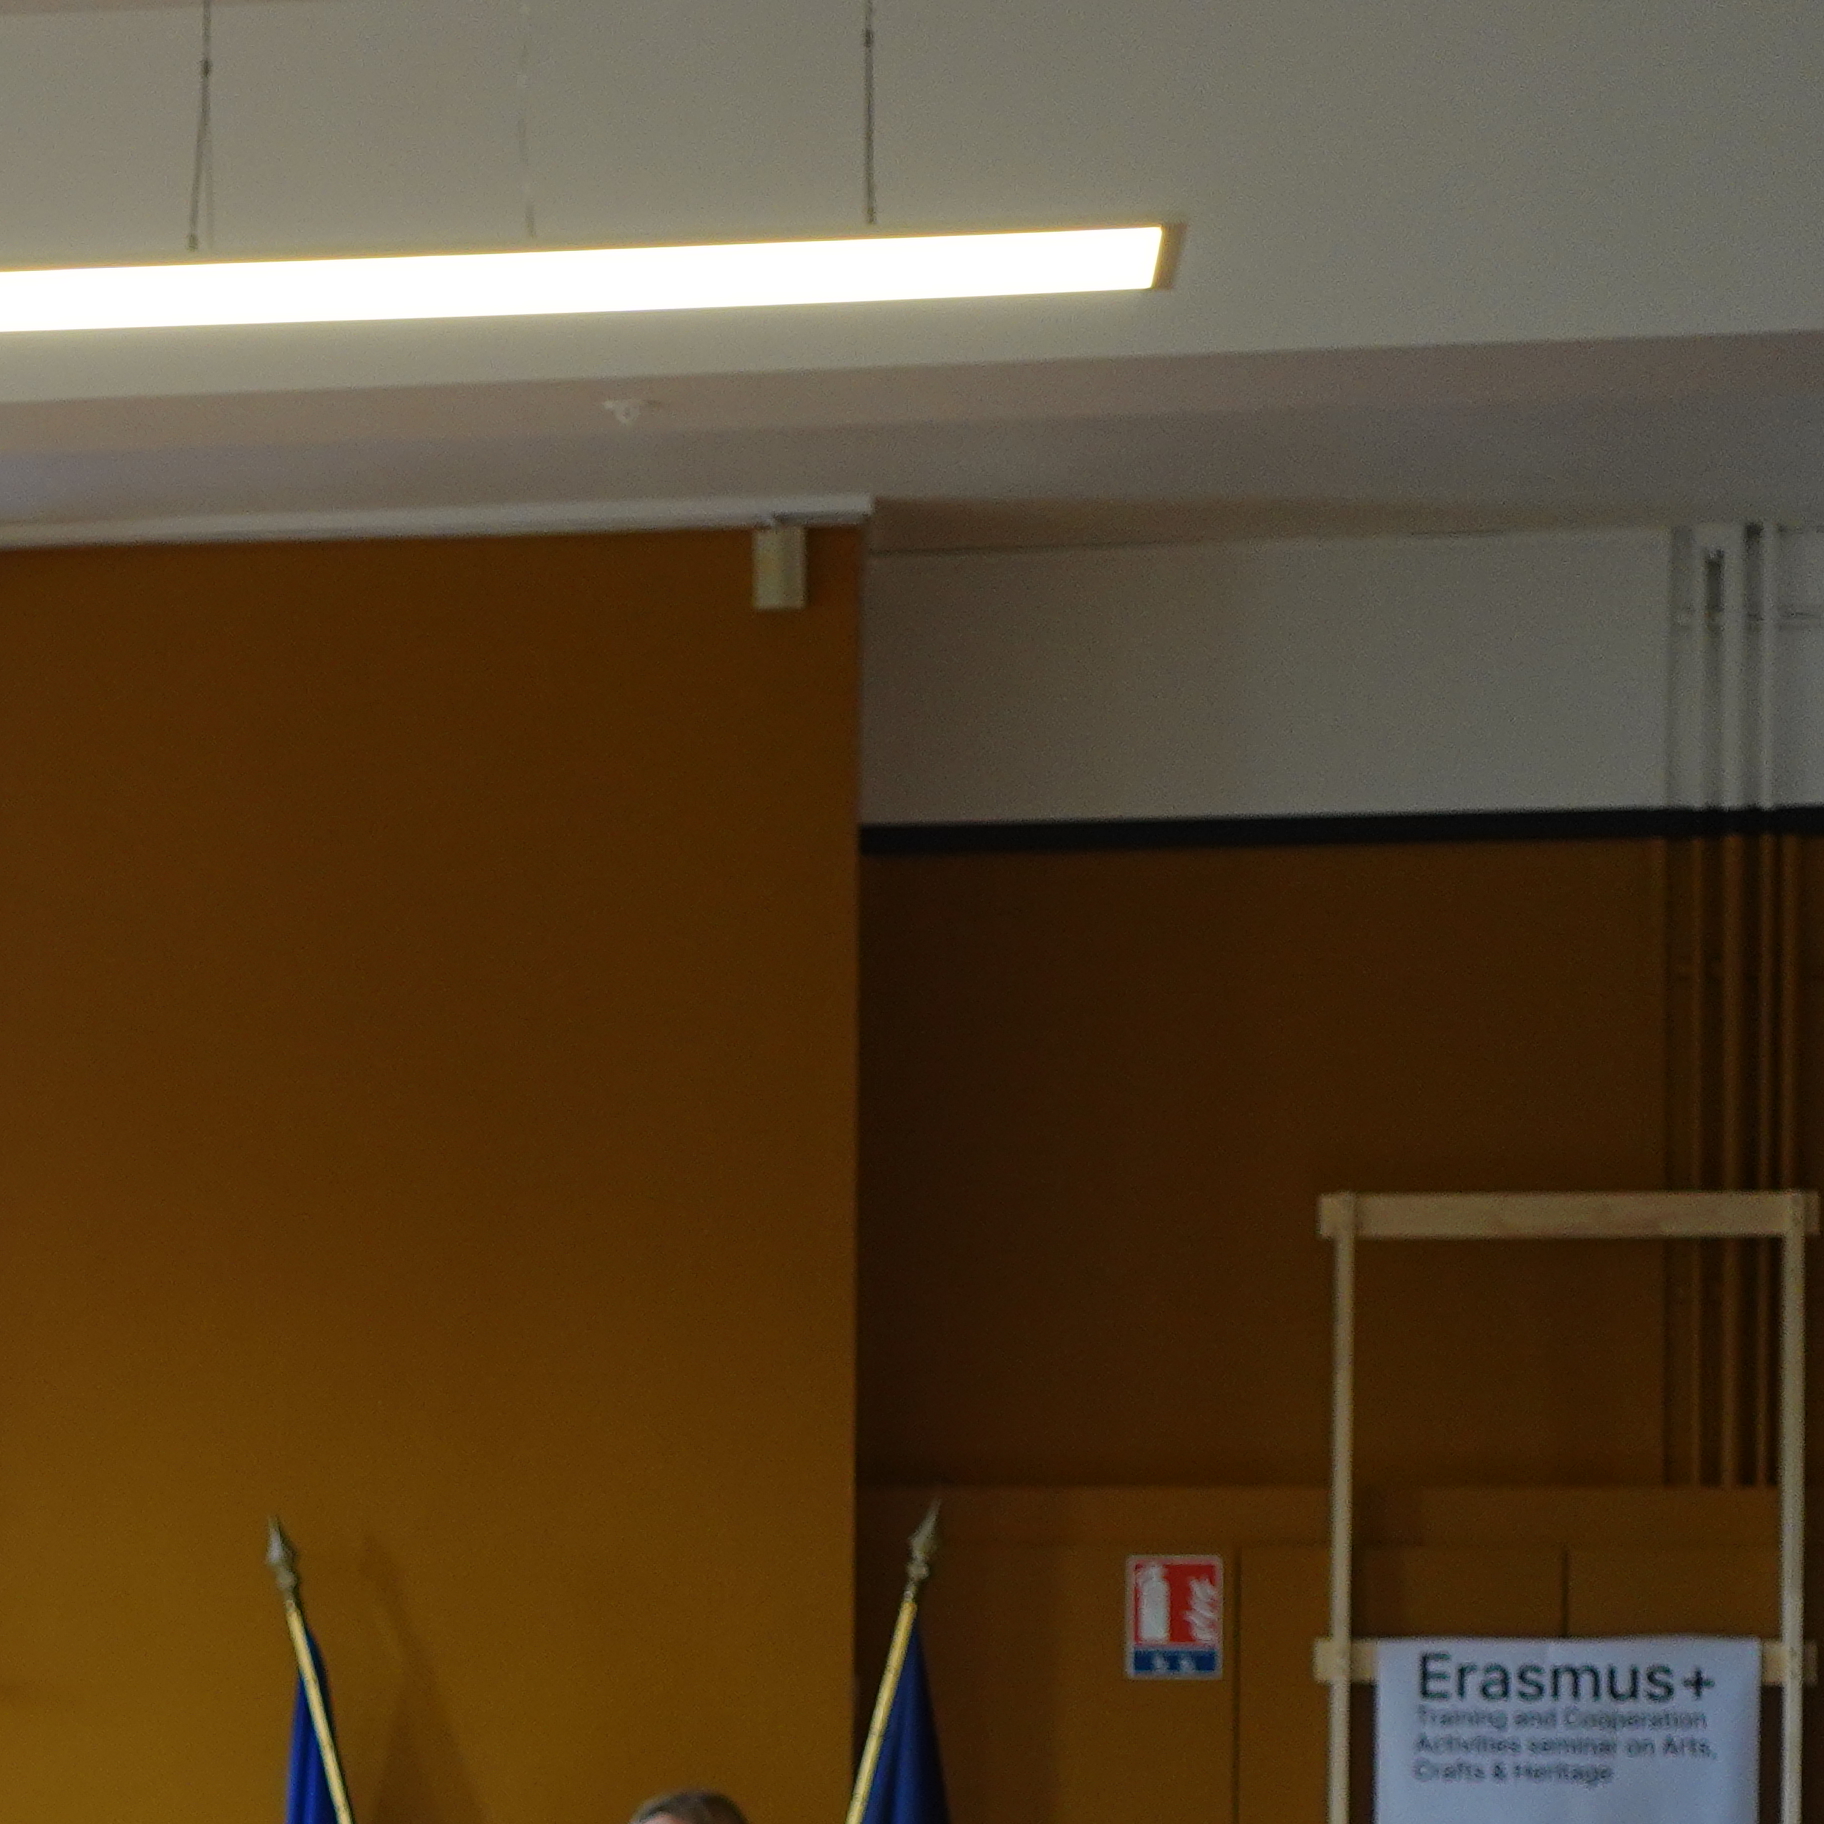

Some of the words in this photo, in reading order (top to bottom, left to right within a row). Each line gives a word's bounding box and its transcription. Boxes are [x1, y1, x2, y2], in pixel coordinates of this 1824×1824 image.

[1419, 1652, 1716, 1702] Erasmus+
[1418, 1704, 1508, 1732] Training
[1512, 1706, 1557, 1728] and
[1561, 1706, 1707, 1731] Cooperation
[1415, 1733, 1521, 1753] Activities
[1527, 1735, 1617, 1755] seminar
[1624, 1738, 1655, 1757] on
[1662, 1735, 1718, 1760] Arts,
[1412, 1757, 1486, 1781] Crafts
[1490, 1760, 1508, 1782] &
[1512, 1762, 1613, 1788] Heritage
